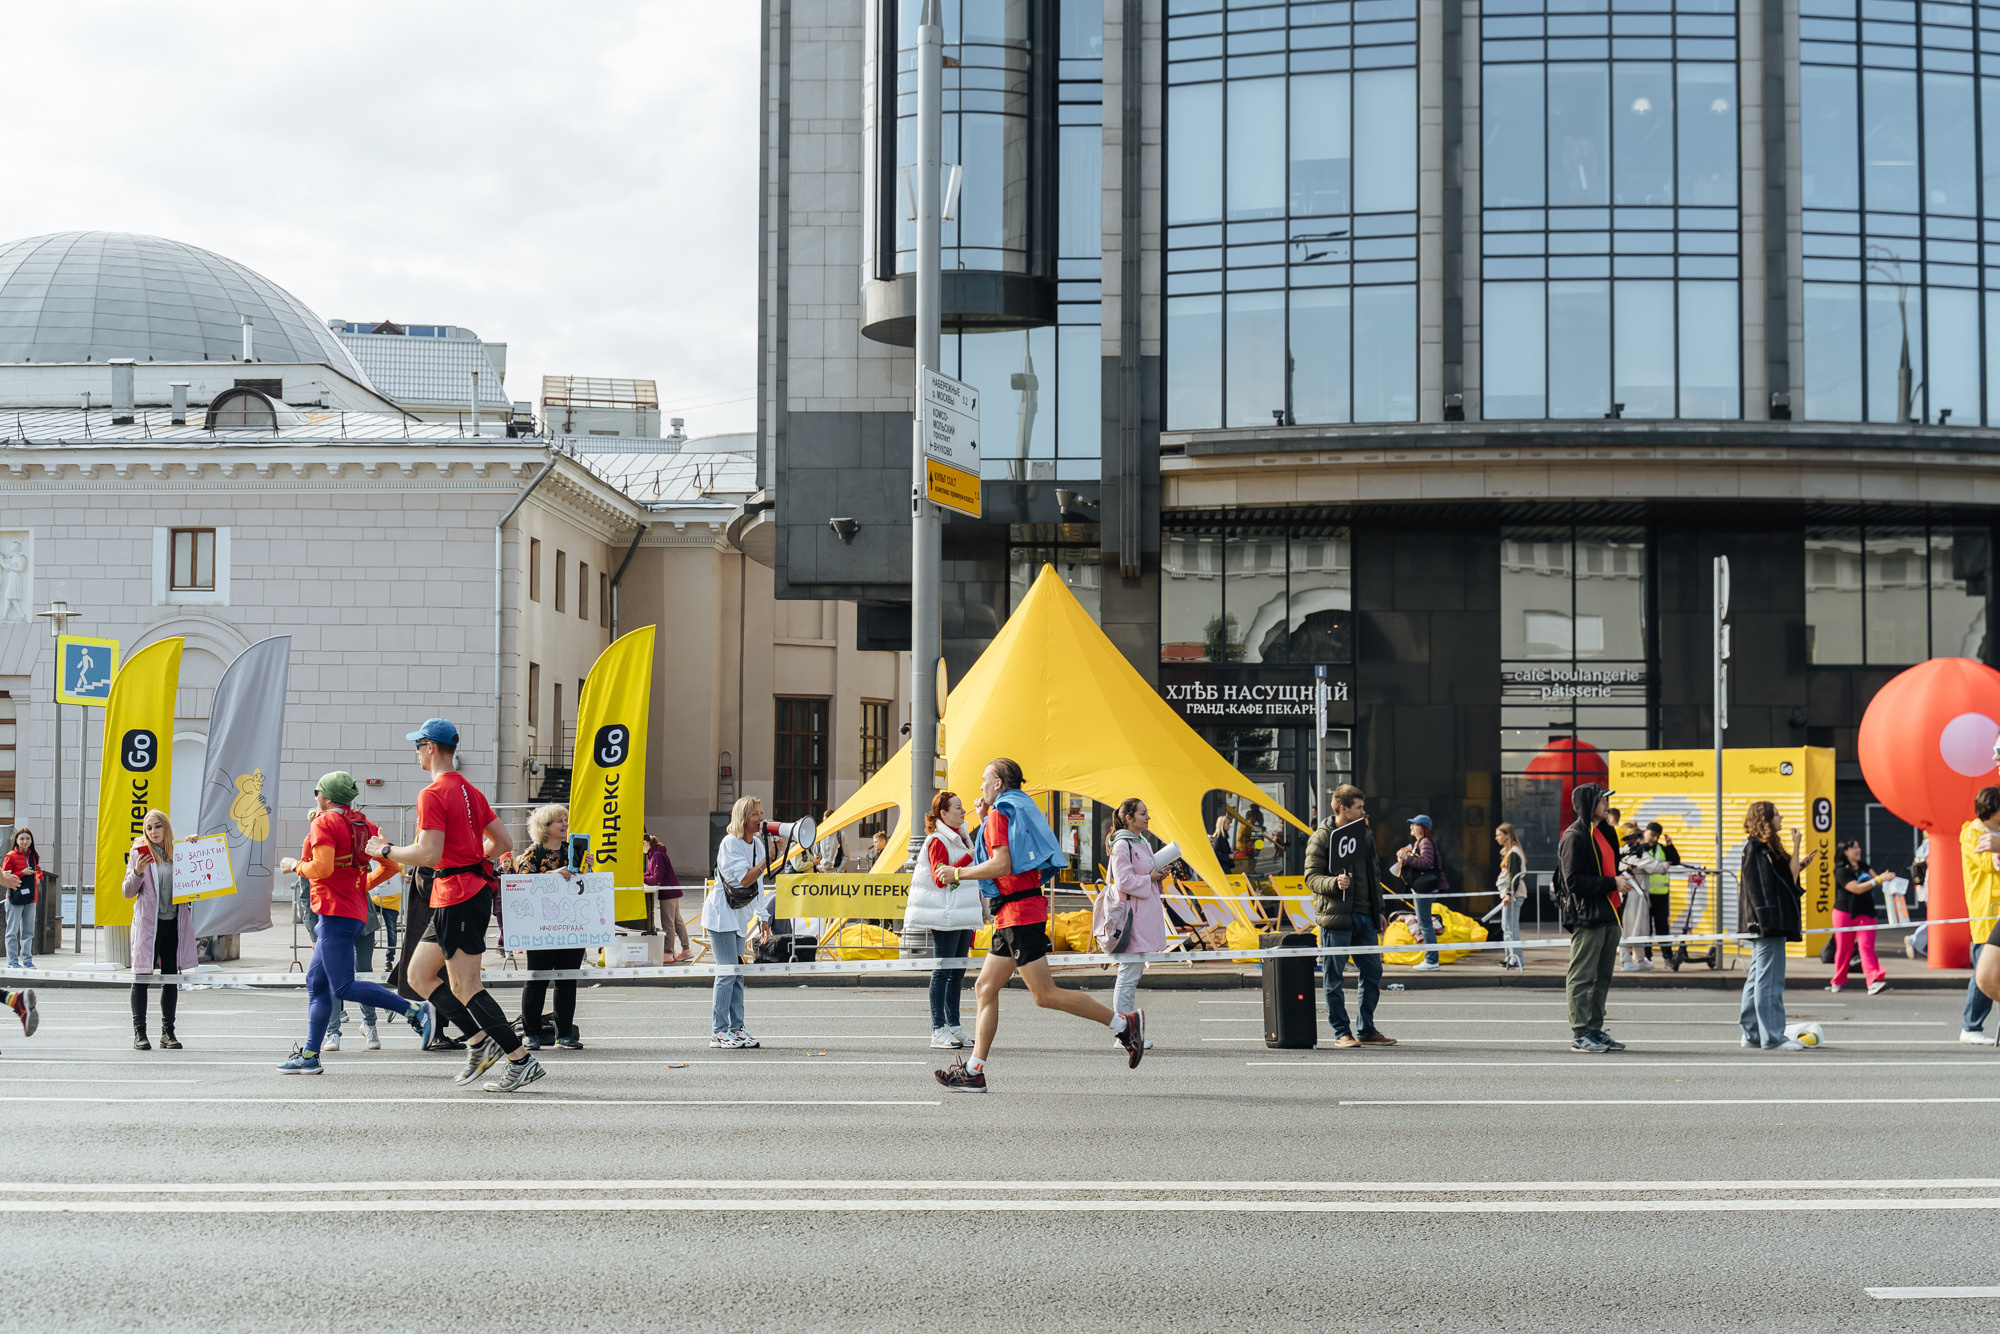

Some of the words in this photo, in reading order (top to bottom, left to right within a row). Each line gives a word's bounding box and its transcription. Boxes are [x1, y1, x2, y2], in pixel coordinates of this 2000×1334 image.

[932, 377, 960, 397] НАБЕРЕЖНЫЕ
[937, 390, 955, 405] МОСКВЫ
[933, 442, 953, 457] ВНУКОВО
[1514, 667, 1545, 681] café
[1550, 668, 1639, 684] boulangerie
[1541, 683, 1611, 699] pâtisserie
[1265, 703, 1317, 715] ПЕКАРН
[128, 734, 151, 768] Go
[601, 728, 624, 763] Go
[1620, 759, 1656, 768] Впишите
[1657, 759, 1676, 768] своё
[1749, 764, 1777, 774] Яндекс
[1780, 762, 1793, 775] Go
[1626, 771, 1661, 779] историю
[1663, 770, 1705, 779] марафона
[124, 779, 148, 865] декс
[595, 773, 621, 864] Яндекс
[1815, 800, 1830, 830] Go
[1338, 835, 1357, 858] Go
[190, 858, 214, 873] ЭТО
[1816, 838, 1831, 913] Яндекс
[791, 884, 861, 898] СТОЛИЦУ
[863, 885, 910, 897] ПЕРЕК
